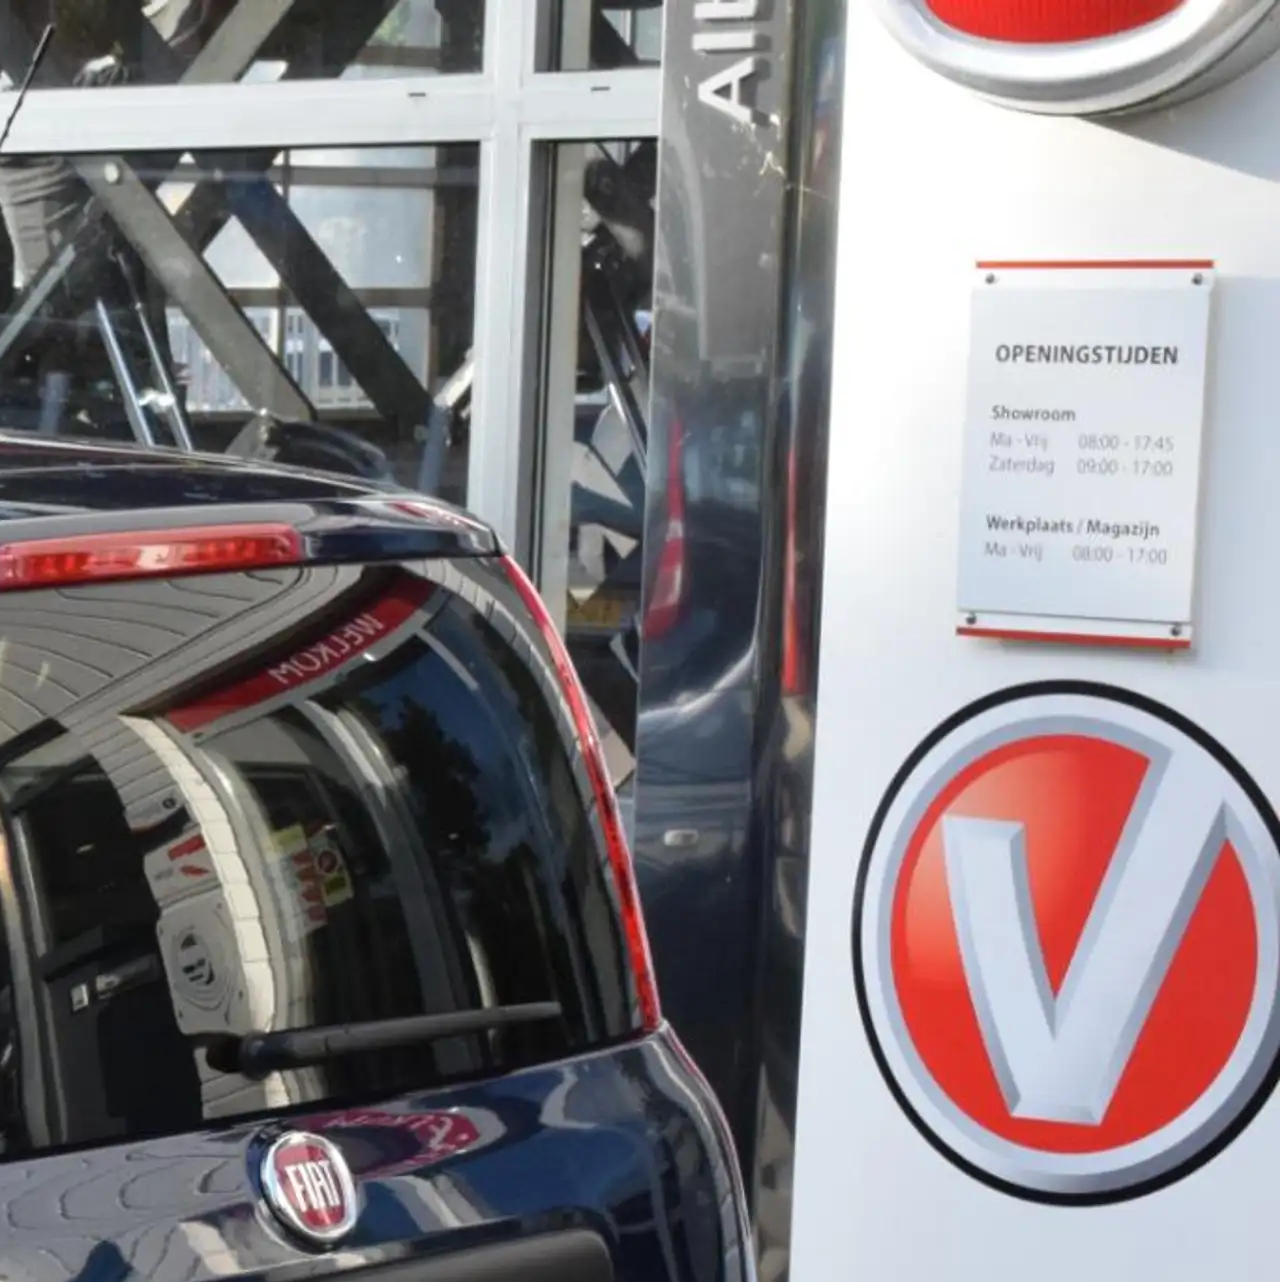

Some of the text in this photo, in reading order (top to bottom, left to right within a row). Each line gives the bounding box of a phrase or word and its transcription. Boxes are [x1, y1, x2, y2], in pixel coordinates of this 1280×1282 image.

[691, 0, 756, 124] Al
[995, 344, 1179, 365] OPENINGSTIJDEN
[991, 405, 1076, 422] Showroom
[990, 432, 1012, 448] Ma
[1077, 434, 1119, 450] 08:00
[1134, 435, 1175, 451] 17:45
[989, 456, 1056, 477] Zaterdag
[1077, 458, 1119, 475] 09:00
[1134, 459, 1174, 476] 17:00
[986, 515, 1074, 536] Werkplaats
[1086, 518, 1160, 540] Magazijn
[984, 542, 1007, 558] Ma
[1072, 545, 1113, 563] 08:00
[1128, 547, 1167, 565] 17:00
[284, 1159, 340, 1213] FIAT
